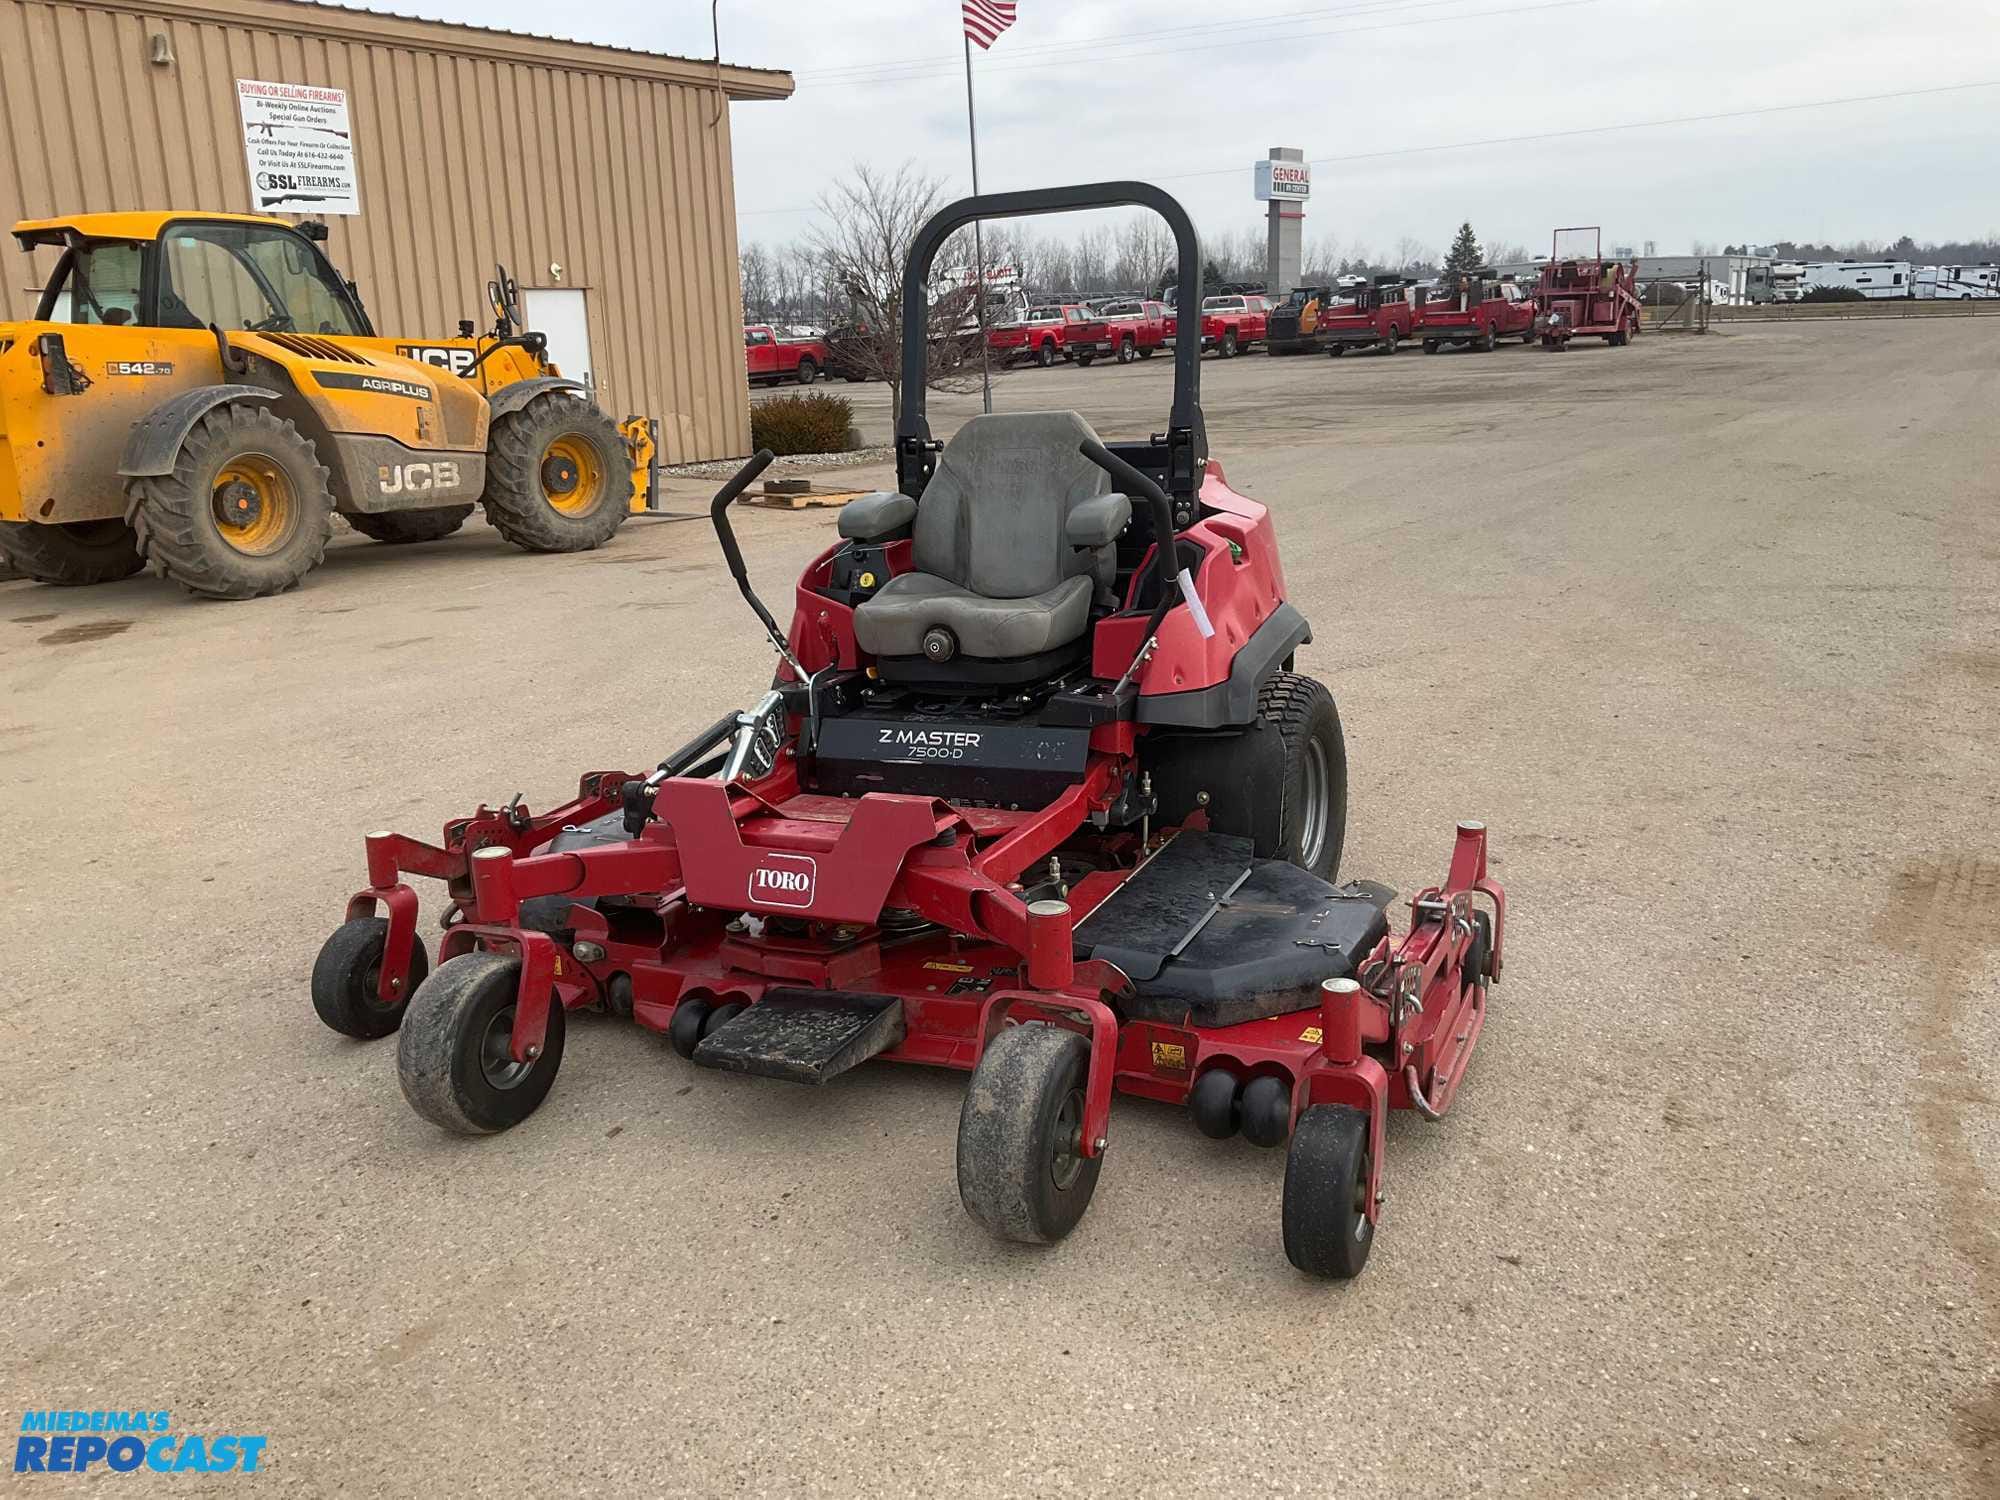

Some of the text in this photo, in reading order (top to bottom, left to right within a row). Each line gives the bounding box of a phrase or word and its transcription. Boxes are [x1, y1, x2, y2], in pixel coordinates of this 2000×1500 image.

[240, 83, 345, 103] BUYING OR SELLING FIREARMS?
[289, 103, 308, 112] Online
[310, 105, 336, 114] Auctions
[269, 112, 291, 122] Special
[306, 116, 327, 124] Orders
[257, 147, 269, 155] Call
[278, 149, 296, 159] Today
[259, 159, 266, 167] Or
[268, 173, 297, 190] SSL
[297, 175, 341, 188] FIREARMS
[1273, 167, 1309, 183] GENERAL
[379, 461, 461, 494] JCB
[879, 729, 980, 747] Z MASTER
[756, 868, 809, 891] TORO
